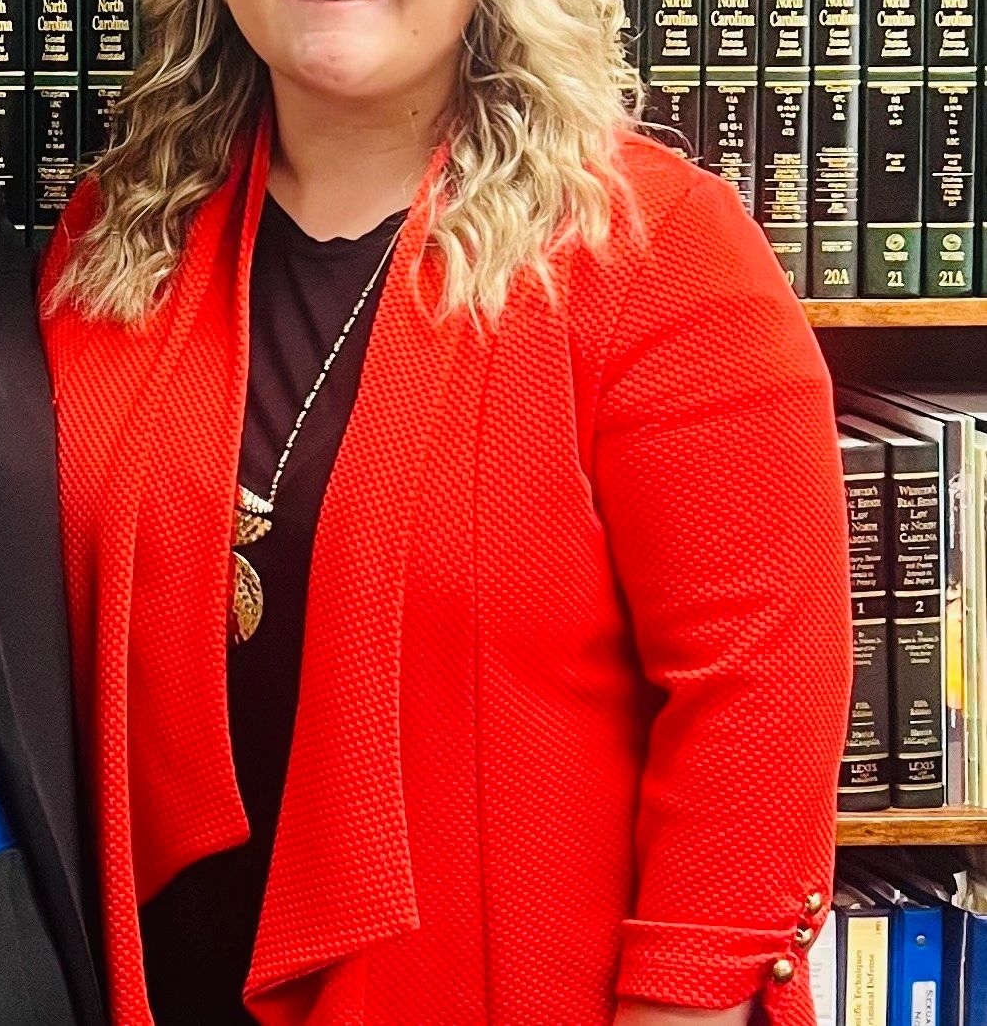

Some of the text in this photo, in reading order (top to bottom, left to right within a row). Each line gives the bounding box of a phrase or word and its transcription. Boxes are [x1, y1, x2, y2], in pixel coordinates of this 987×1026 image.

[38, 15, 73, 31] Carolina
[92, 15, 129, 30] Carolina
[655, 10, 698, 26] Carolina
[711, 10, 755, 26] Carolina
[770, 11, 808, 27] Carolina
[819, 10, 859, 26] Carolina
[877, 10, 915, 26] Carolina
[935, 11, 973, 27] Carolina
[824, 269, 850, 284] 20A
[888, 271, 904, 286] 21
[939, 270, 966, 286] 21A
[857, 602, 864, 613] 1
[916, 601, 924, 612] 2
[853, 949, 863, 999] Techniques
[866, 953, 875, 988] Defense
